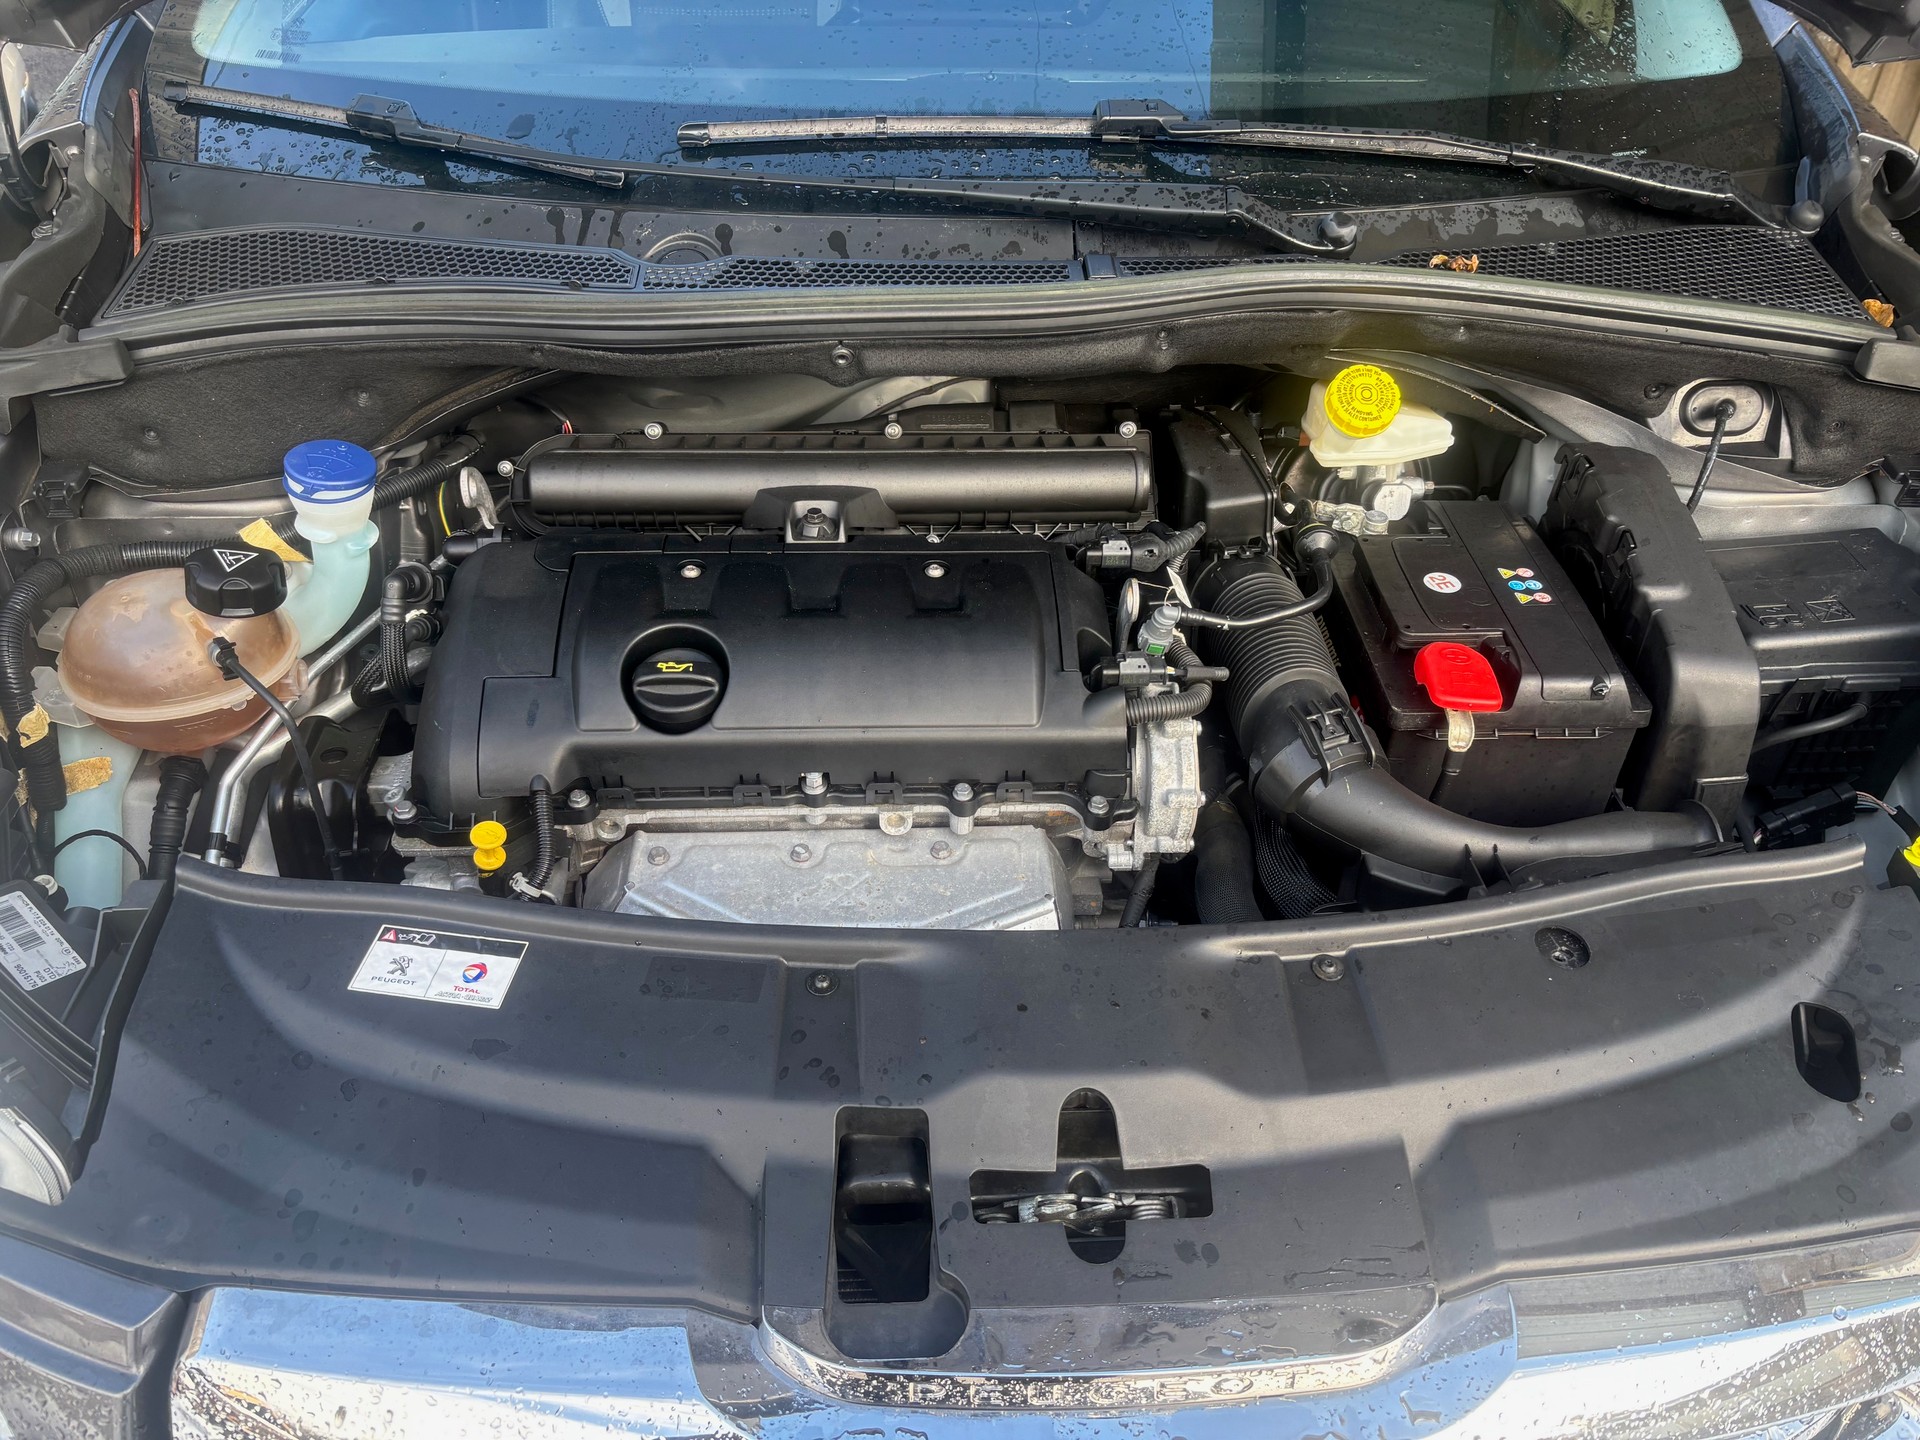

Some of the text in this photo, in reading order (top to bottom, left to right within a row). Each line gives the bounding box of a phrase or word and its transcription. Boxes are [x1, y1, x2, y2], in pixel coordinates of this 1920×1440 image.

[1429, 574, 1456, 590] 2E
[43, 967, 57, 980] DTD
[371, 975, 417, 986] PEUGEOT
[453, 985, 481, 995] TOTAL
